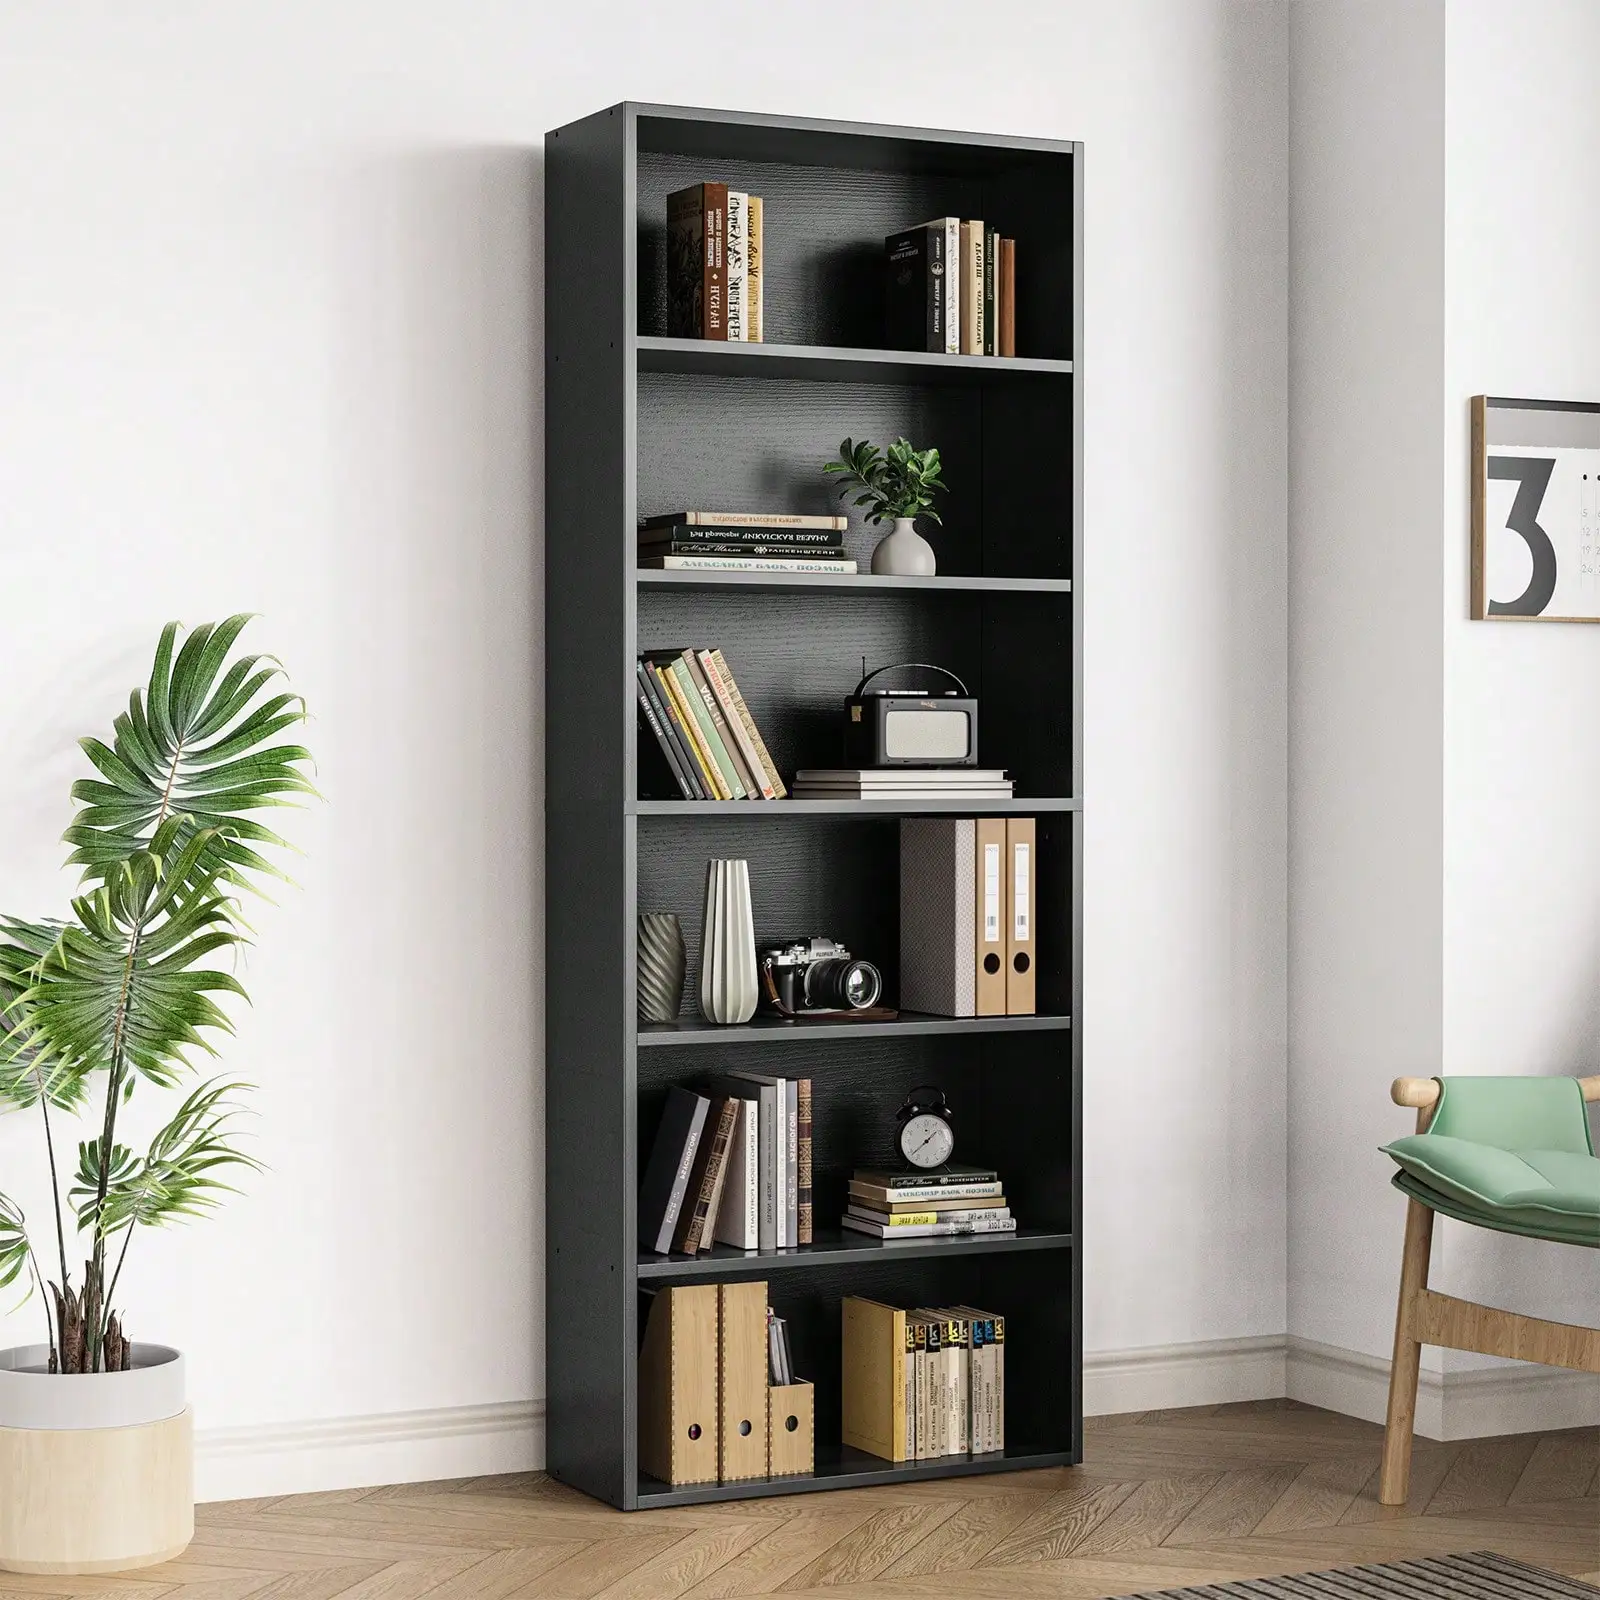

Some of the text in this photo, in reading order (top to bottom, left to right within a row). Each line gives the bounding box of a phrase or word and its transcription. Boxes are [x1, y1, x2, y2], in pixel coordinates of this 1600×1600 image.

[681, 560, 752, 568] АЛЕКСАНДР
[796, 564, 845, 572] ПОЭМЫ
[1487, 456, 1557, 616] 3
